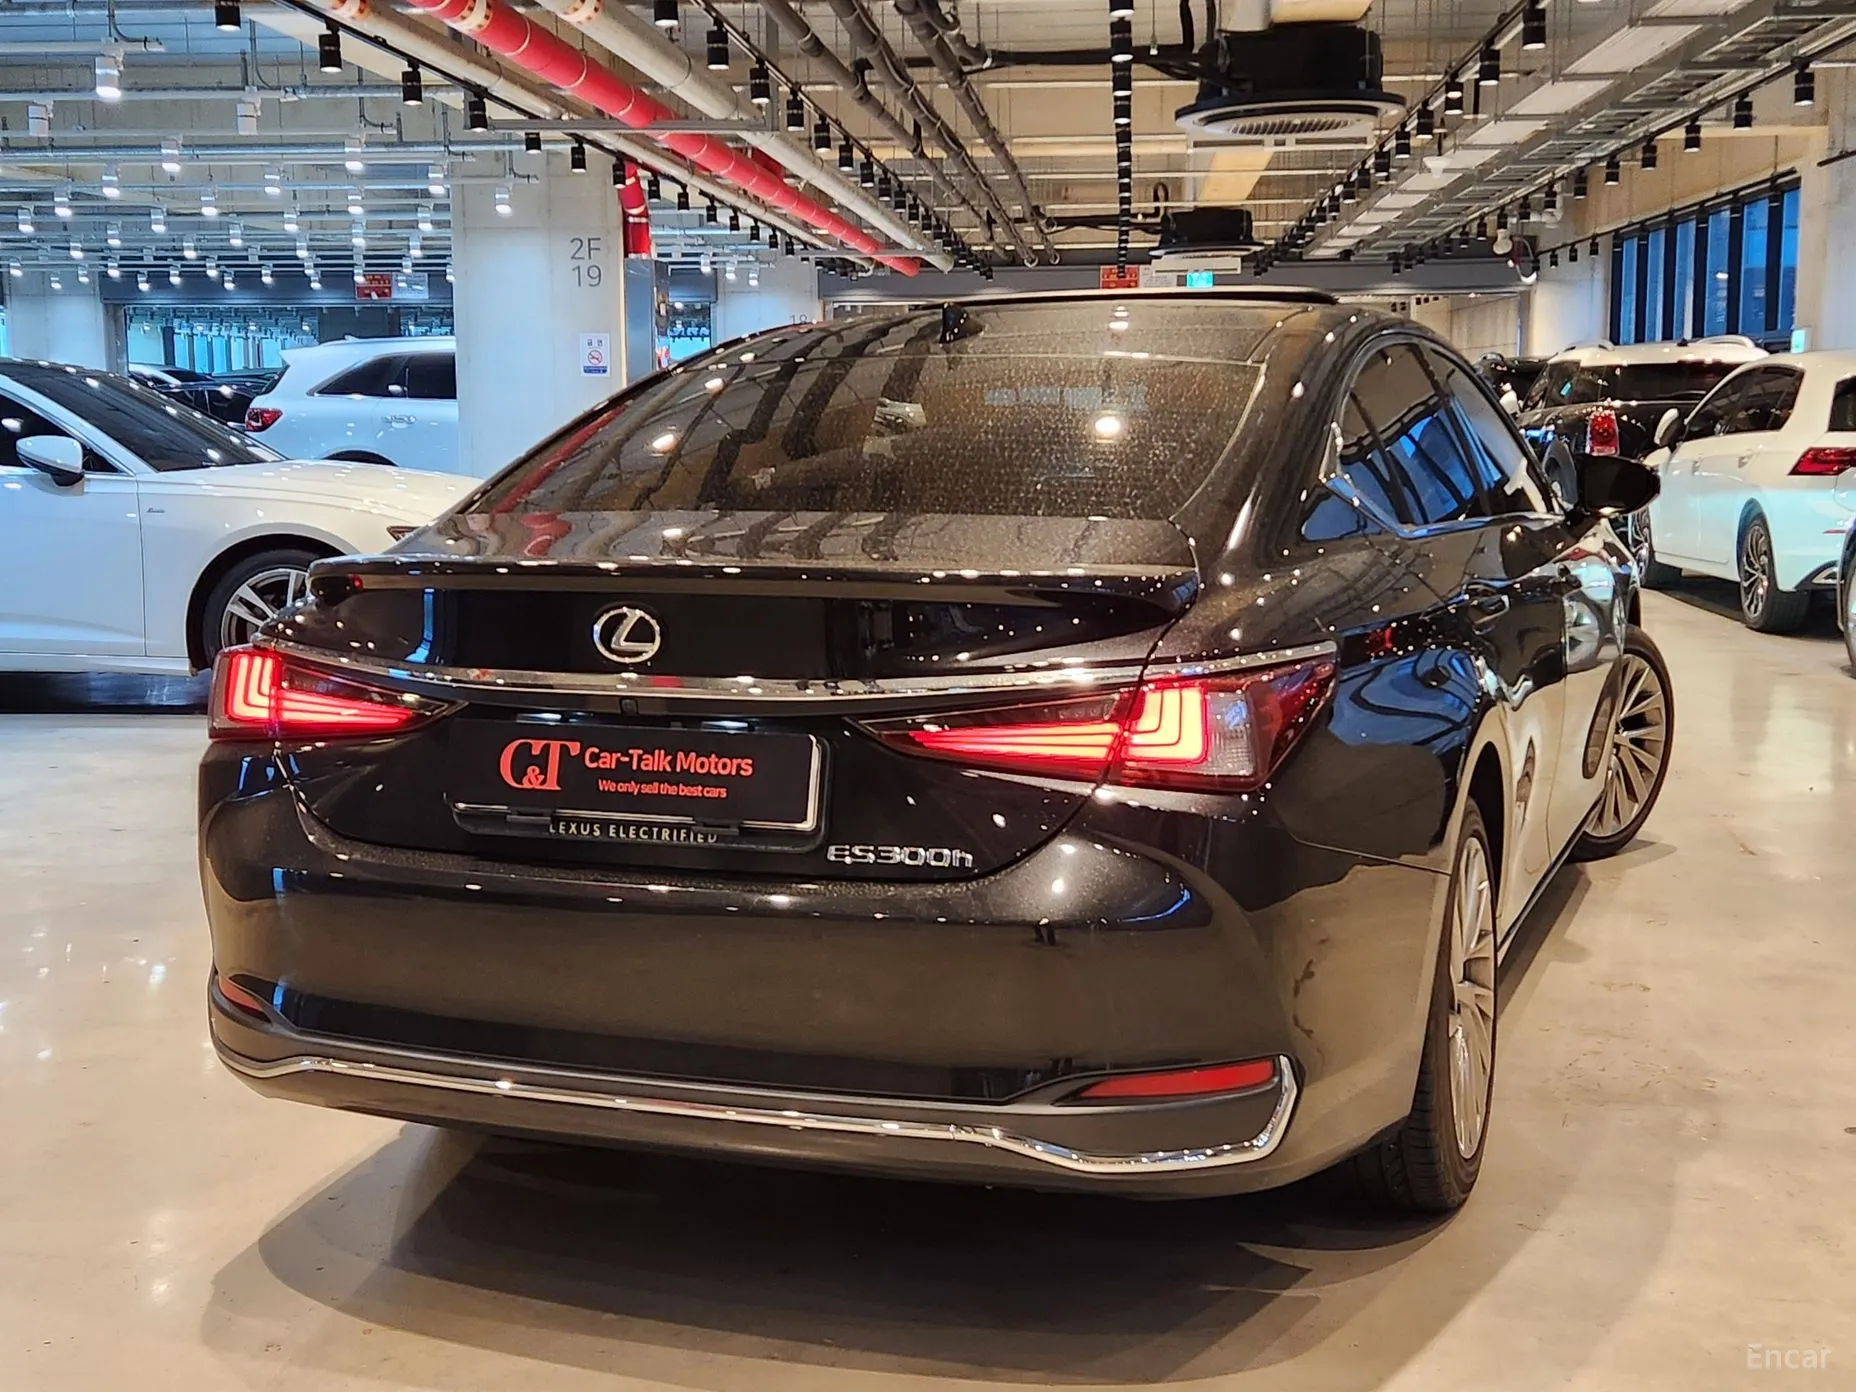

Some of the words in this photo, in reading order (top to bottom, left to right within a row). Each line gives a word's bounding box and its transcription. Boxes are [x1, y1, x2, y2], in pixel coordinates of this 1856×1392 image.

[570, 237, 602, 261] 2F
[571, 264, 602, 288] 19
[584, 746, 672, 773] Car-Talk
[675, 751, 754, 777] Motors
[598, 779, 617, 792] We
[617, 781, 640, 796] only
[641, 782, 659, 794] sell
[660, 783, 678, 795] the
[679, 784, 703, 797] best
[703, 787, 728, 798] cars
[549, 821, 601, 836] LEXUS
[608, 824, 718, 843] ELECTRIFIED
[826, 844, 974, 868] ES300h
